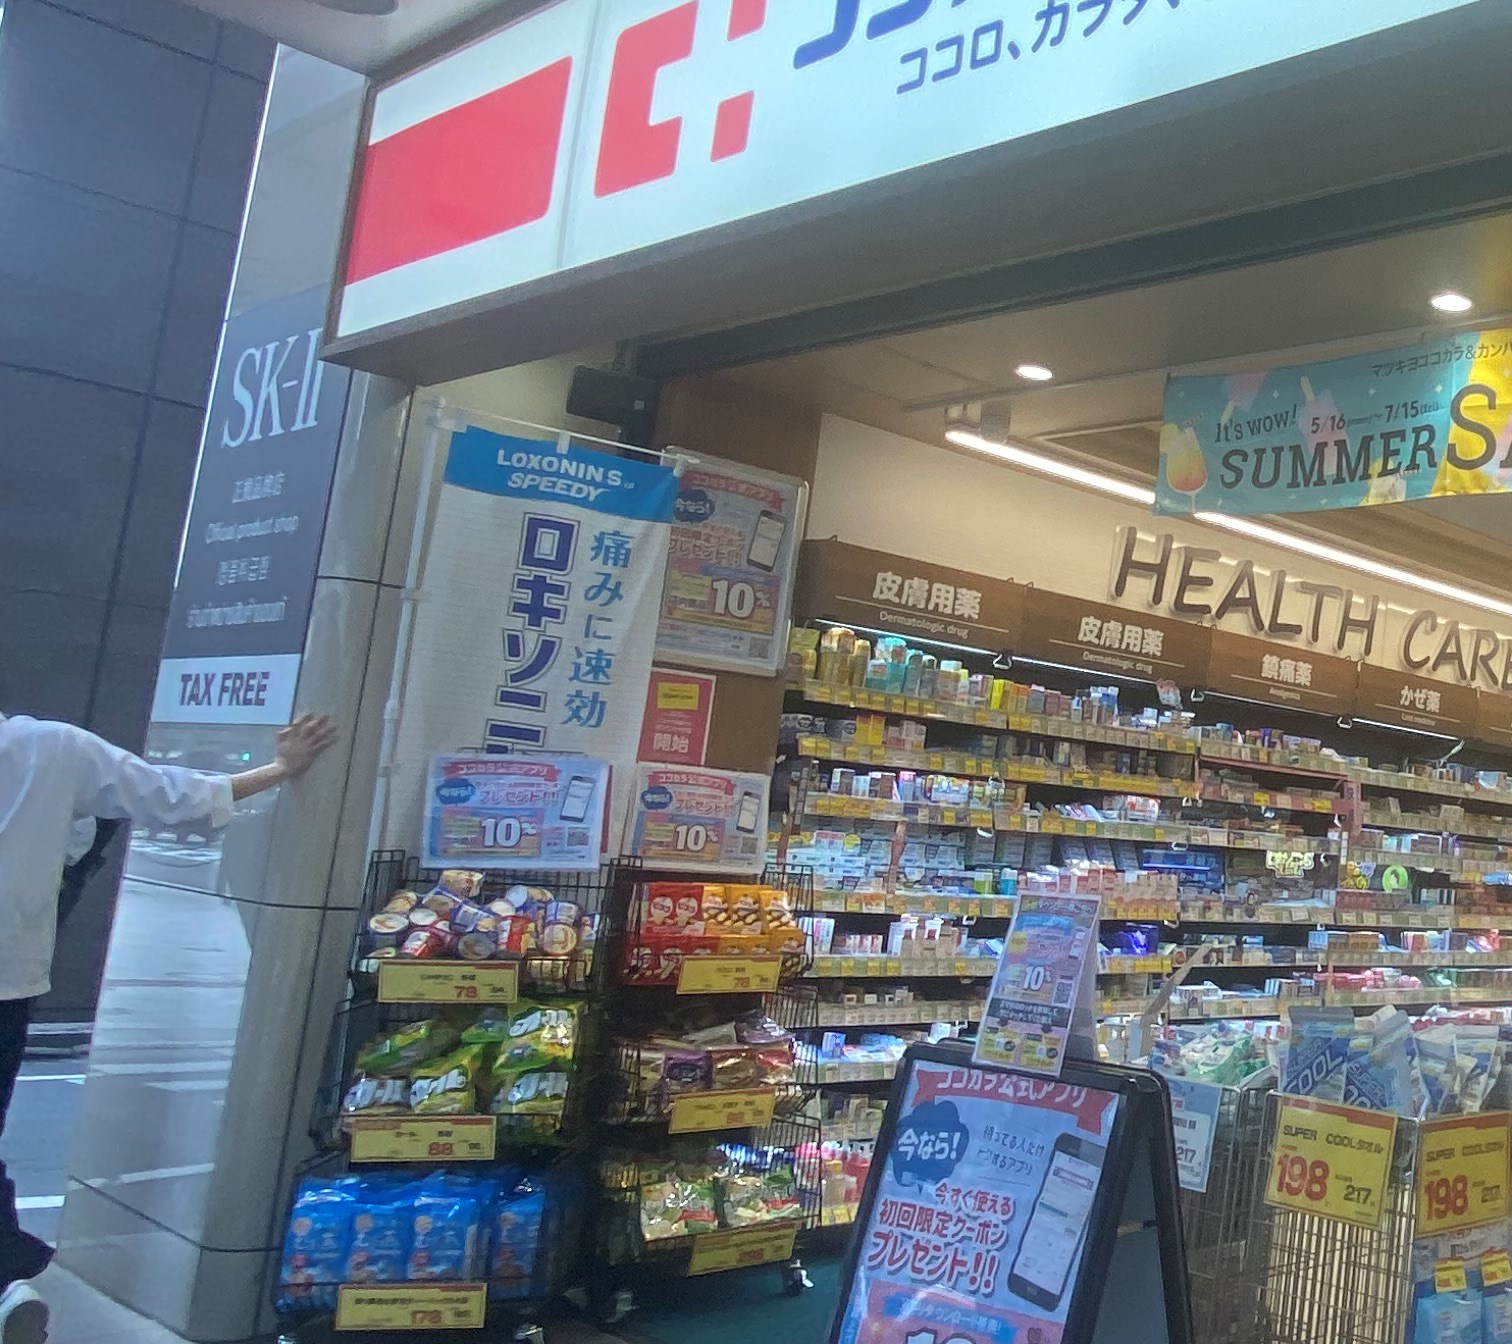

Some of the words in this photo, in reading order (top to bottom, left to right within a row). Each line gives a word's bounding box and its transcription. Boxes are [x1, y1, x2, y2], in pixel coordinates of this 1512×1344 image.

[497, 449, 604, 483] LOXONIN
[1219, 422, 1437, 490] SUMMER
[507, 472, 611, 502] SPEEDY
[712, 579, 771, 619] 10%
[872, 571, 982, 620] 皮膚用薬
[1112, 526, 1379, 657] HEALTH
[484, 512, 580, 755] ロキソニ
[560, 529, 635, 728] 痛みに速効
[879, 611, 944, 634] Dermatologic
[945, 622, 969, 640] drug
[1077, 615, 1165, 657] 皮膚用薬
[179, 673, 216, 707] TAX
[217, 671, 271, 706] FREE
[1400, 685, 1442, 714] かぜ薬
[481, 817, 537, 848] 10%
[675, 824, 720, 852] 10%
[898, 1128, 961, 1161] 今なら!
[1282, 1124, 1318, 1142] SUPER
[1276, 1153, 1330, 1202] 198
[1343, 1184, 1372, 1206] 217
[935, 1182, 1016, 1218] 今すぐ使える
[1424, 1174, 1469, 1221] 198
[880, 1197, 1006, 1248] 初回限定クーポン
[867, 1229, 998, 1291] プレゼント!!
